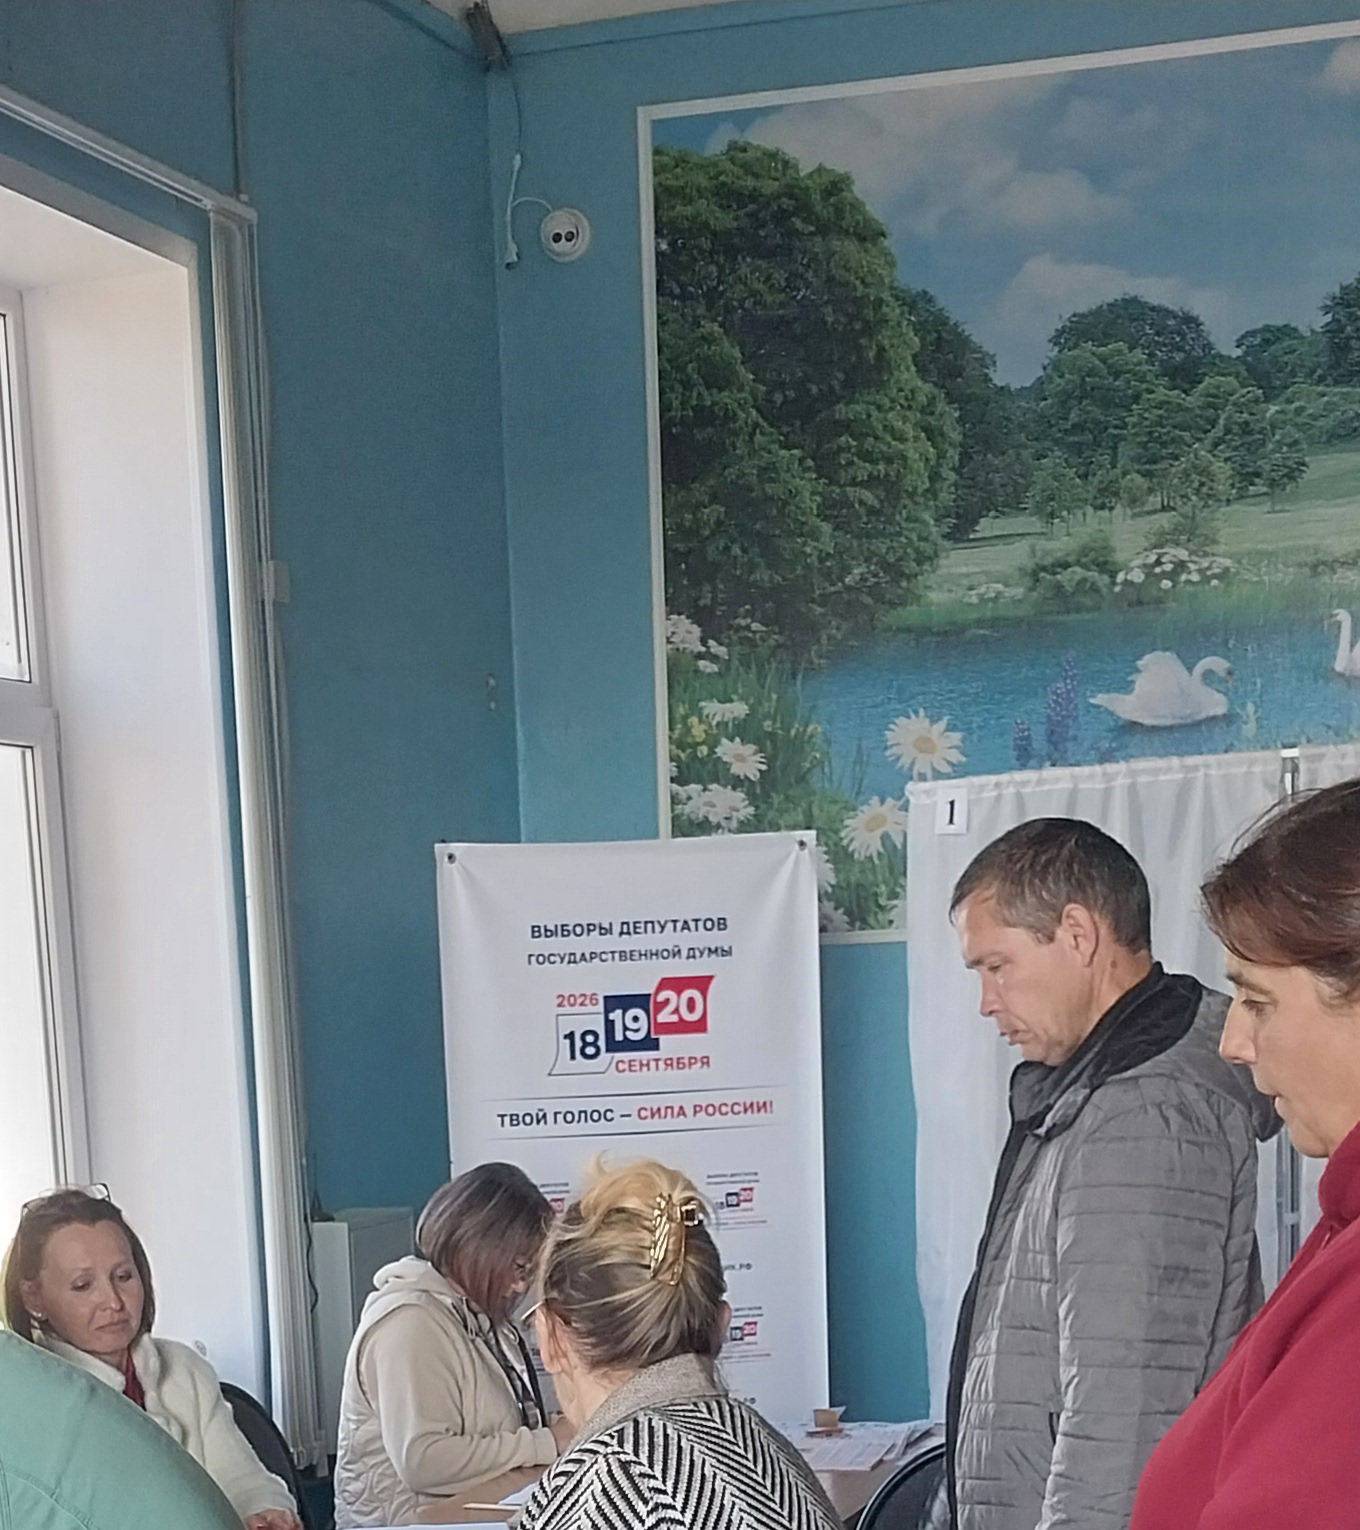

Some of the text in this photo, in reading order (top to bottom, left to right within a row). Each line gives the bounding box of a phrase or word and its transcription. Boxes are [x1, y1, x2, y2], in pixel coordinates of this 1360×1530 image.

[946, 799, 956, 826] 1
[530, 916, 728, 940] ВЫБОРЫ ДЕПУТАТОВ
[527, 945, 733, 966] ГОСУДАРСТВЕННОЙ ДУМЫ
[556, 993, 599, 1008] 2026
[563, 989, 705, 1061] 18 19 20
[614, 1055, 711, 1074] СЕНТЯБРЯ
[497, 1107, 548, 1128] ТВОЙ
[553, 1109, 615, 1126] ГОЛОС
[637, 1105, 687, 1122] СИЛА
[693, 1099, 774, 1118] РОССИИ!
